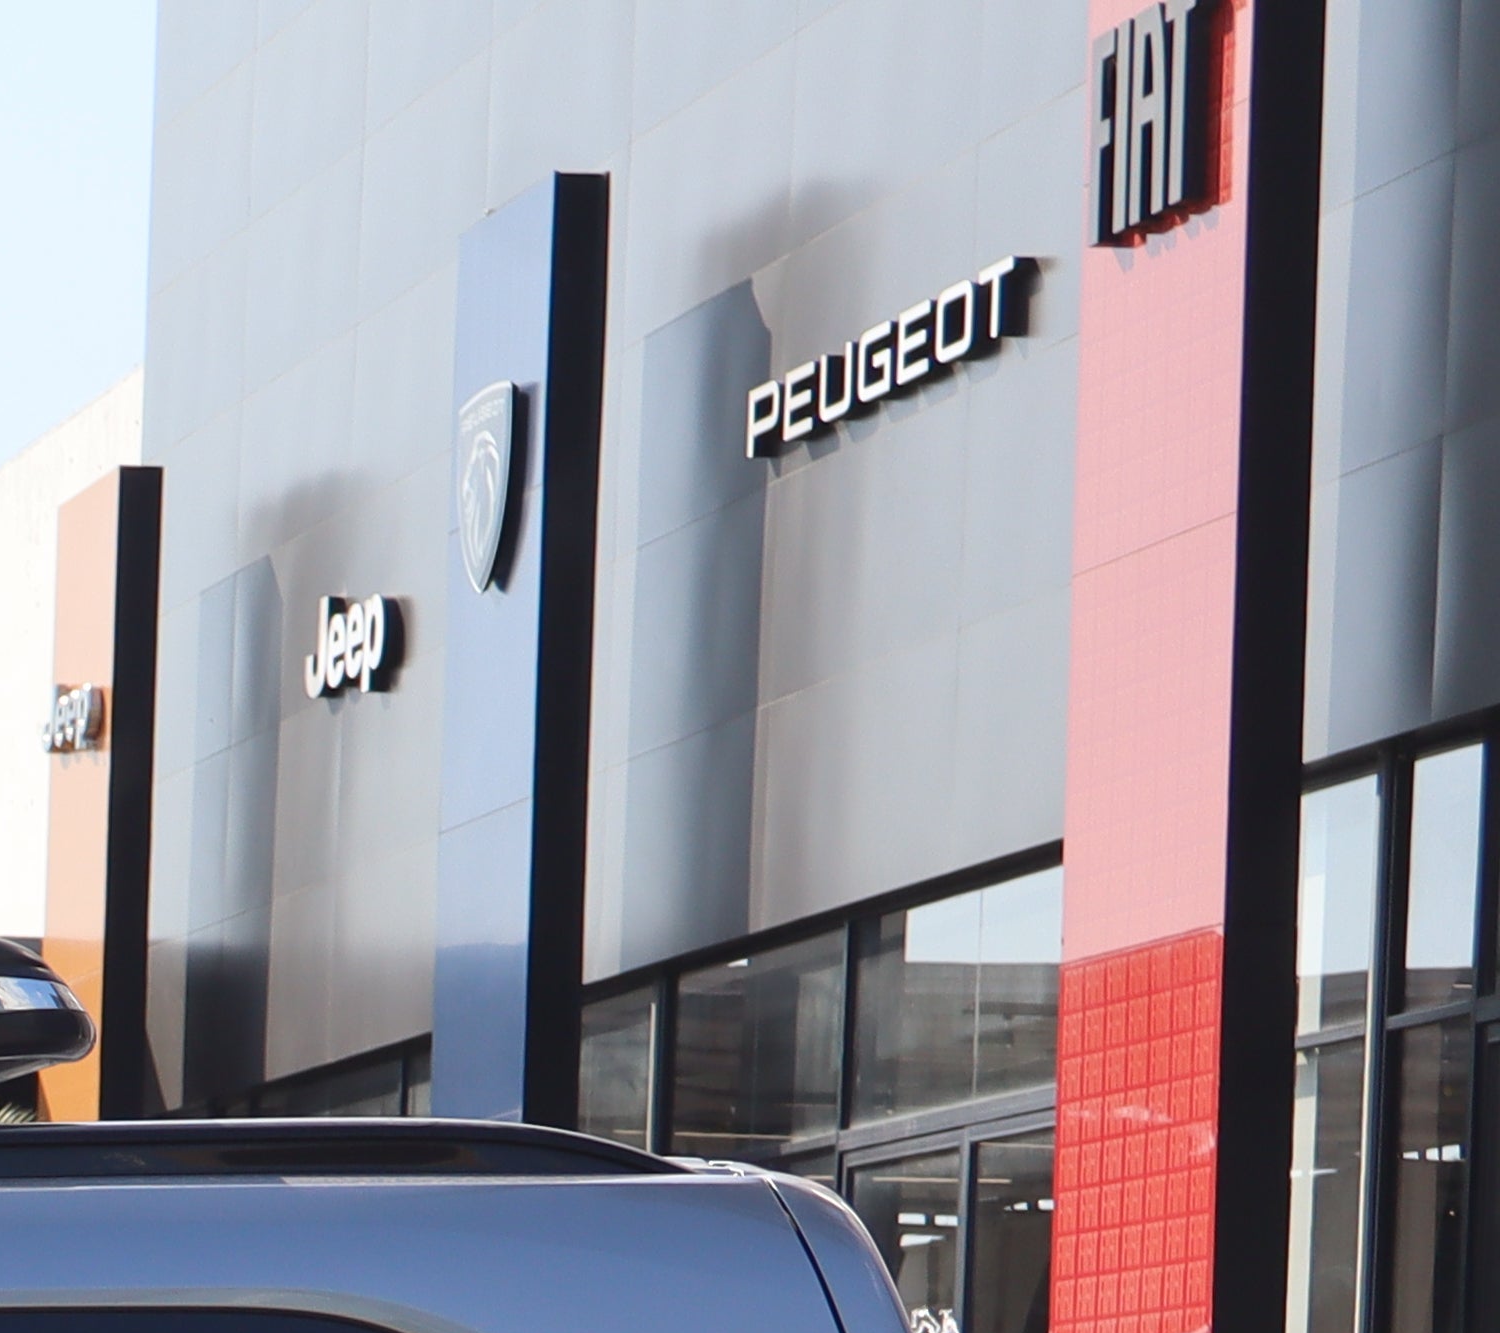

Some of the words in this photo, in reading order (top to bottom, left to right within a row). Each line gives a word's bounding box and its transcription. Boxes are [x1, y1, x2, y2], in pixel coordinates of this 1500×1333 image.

[1088, 0, 1197, 247] FIAT
[746, 255, 1016, 459] PEUGEOT
[304, 593, 385, 699] Jeep
